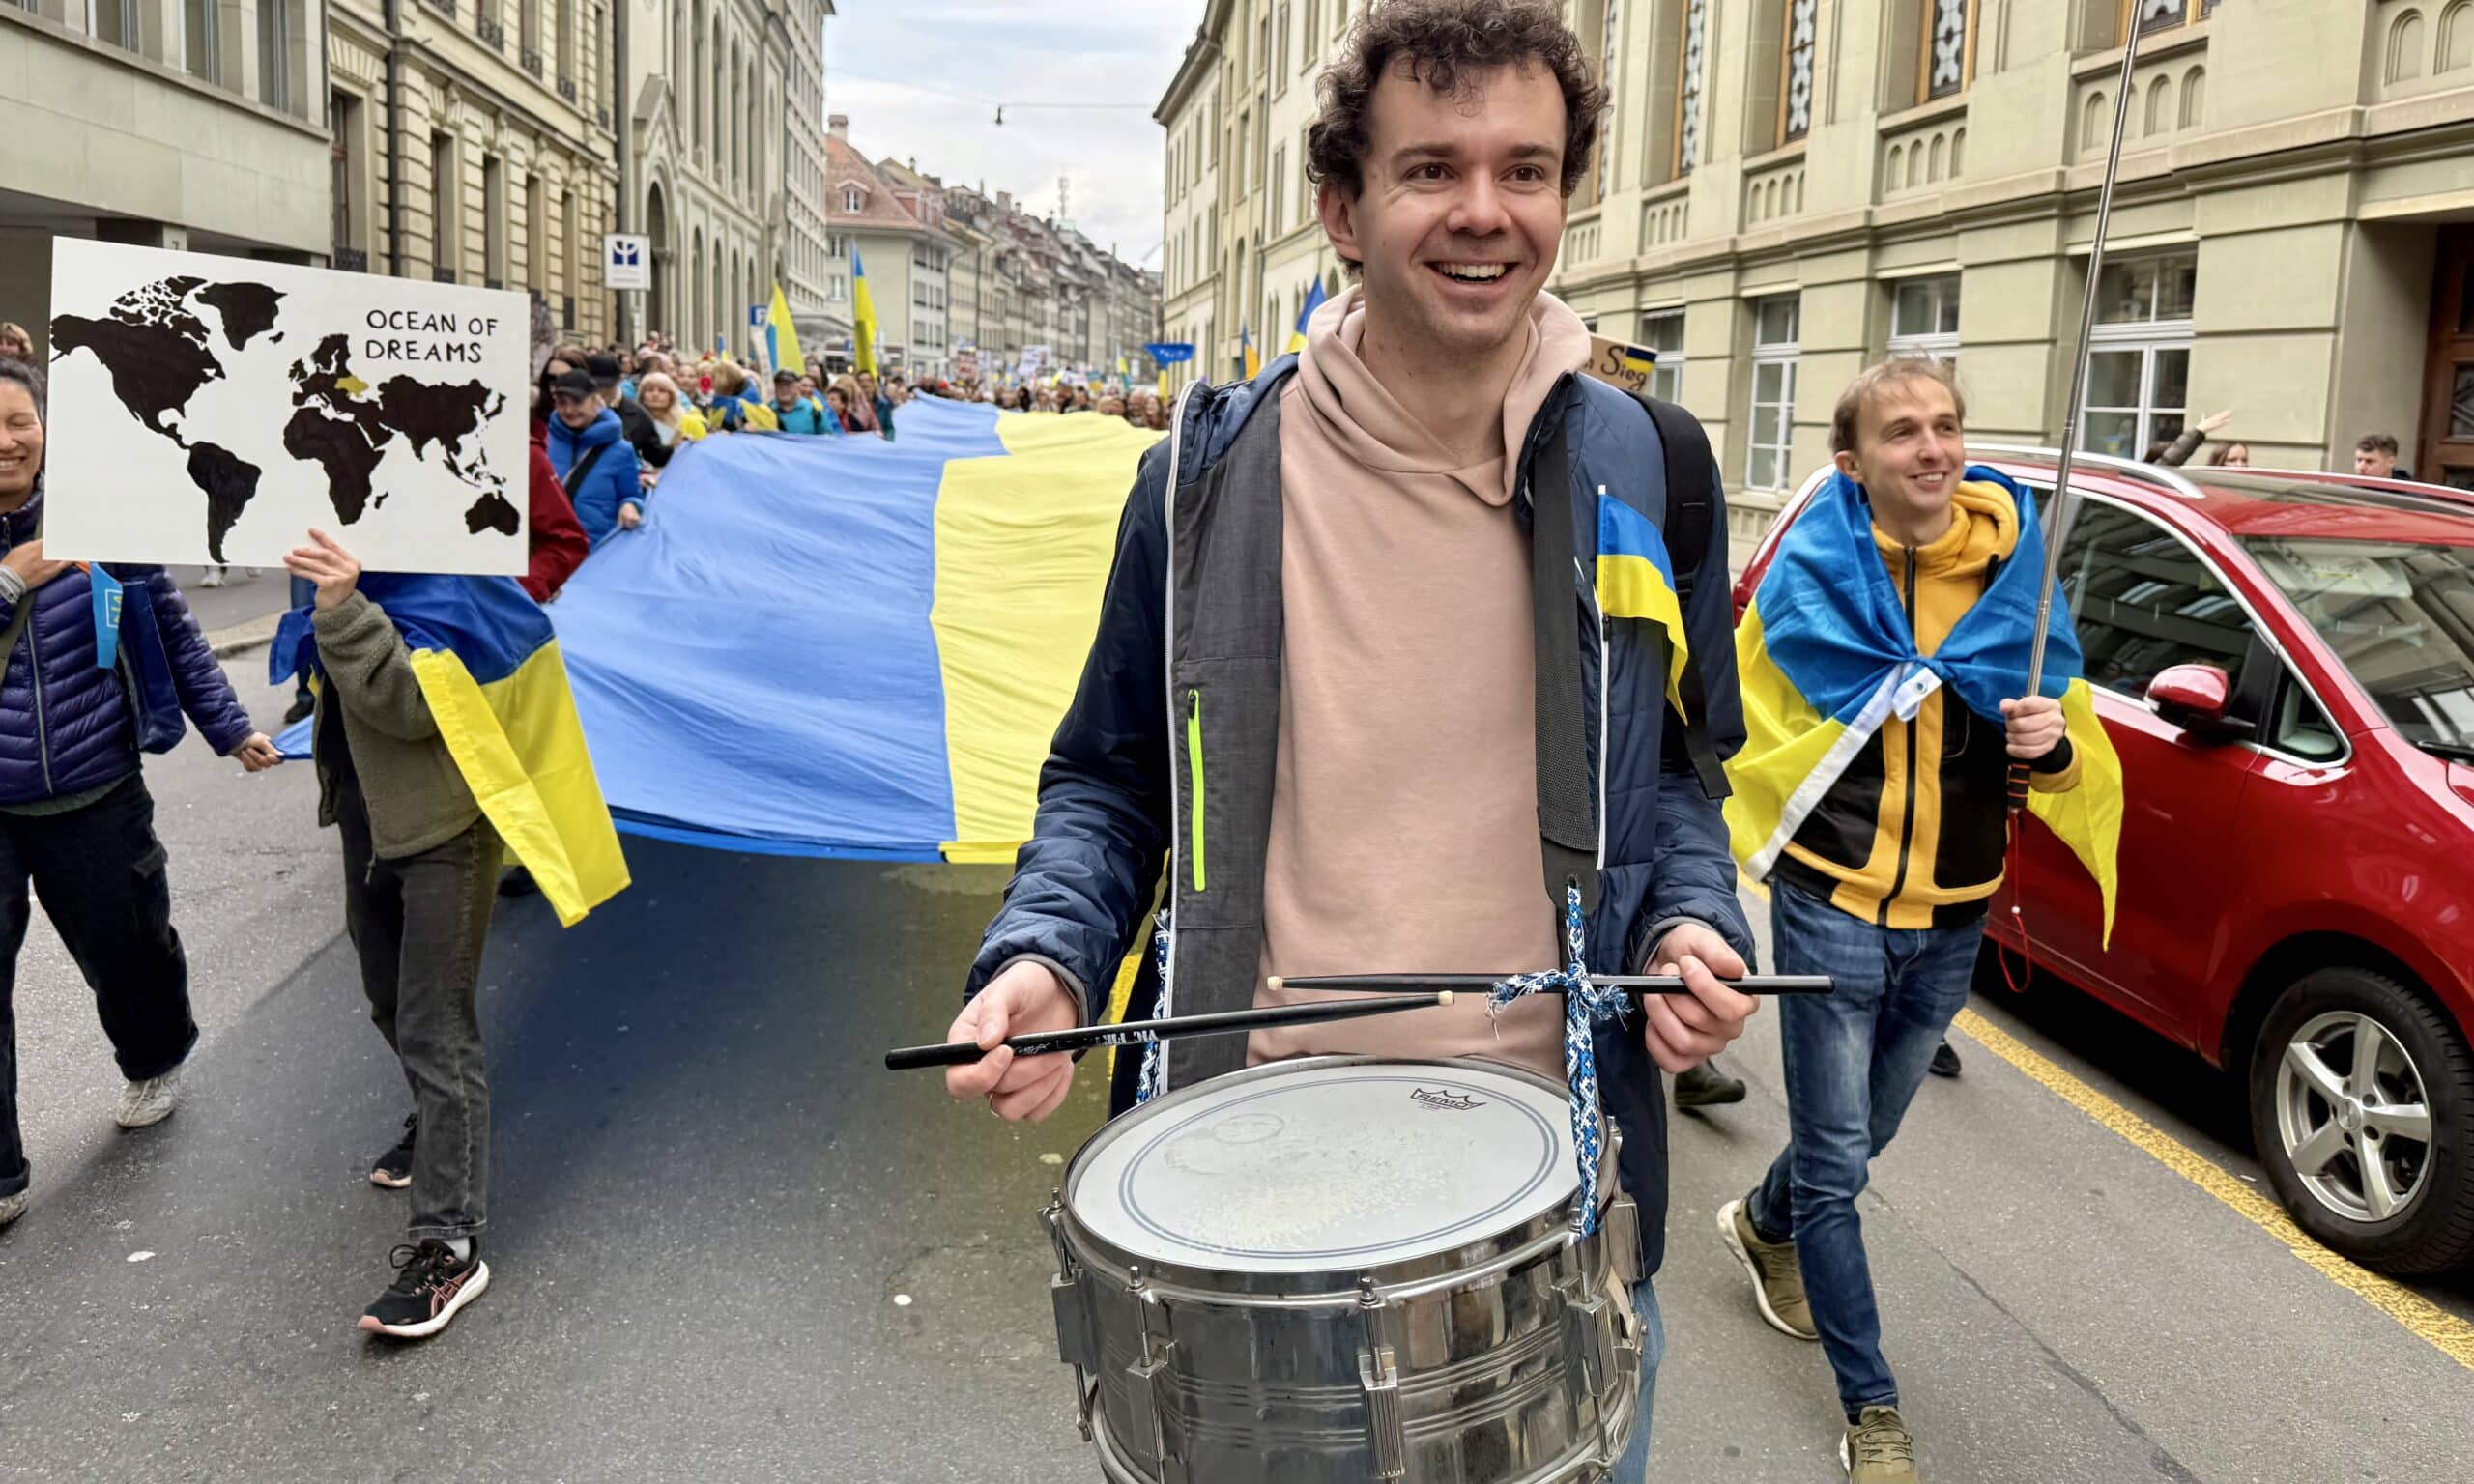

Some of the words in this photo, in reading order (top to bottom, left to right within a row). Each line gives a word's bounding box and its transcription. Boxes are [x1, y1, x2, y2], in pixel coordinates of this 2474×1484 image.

[366, 309, 456, 333] OCEAN
[468, 317, 498, 336] OF
[365, 339, 482, 364] DREAMS
[1600, 344, 1647, 391] Sieg
[1417, 1093, 1469, 1109] REMO
